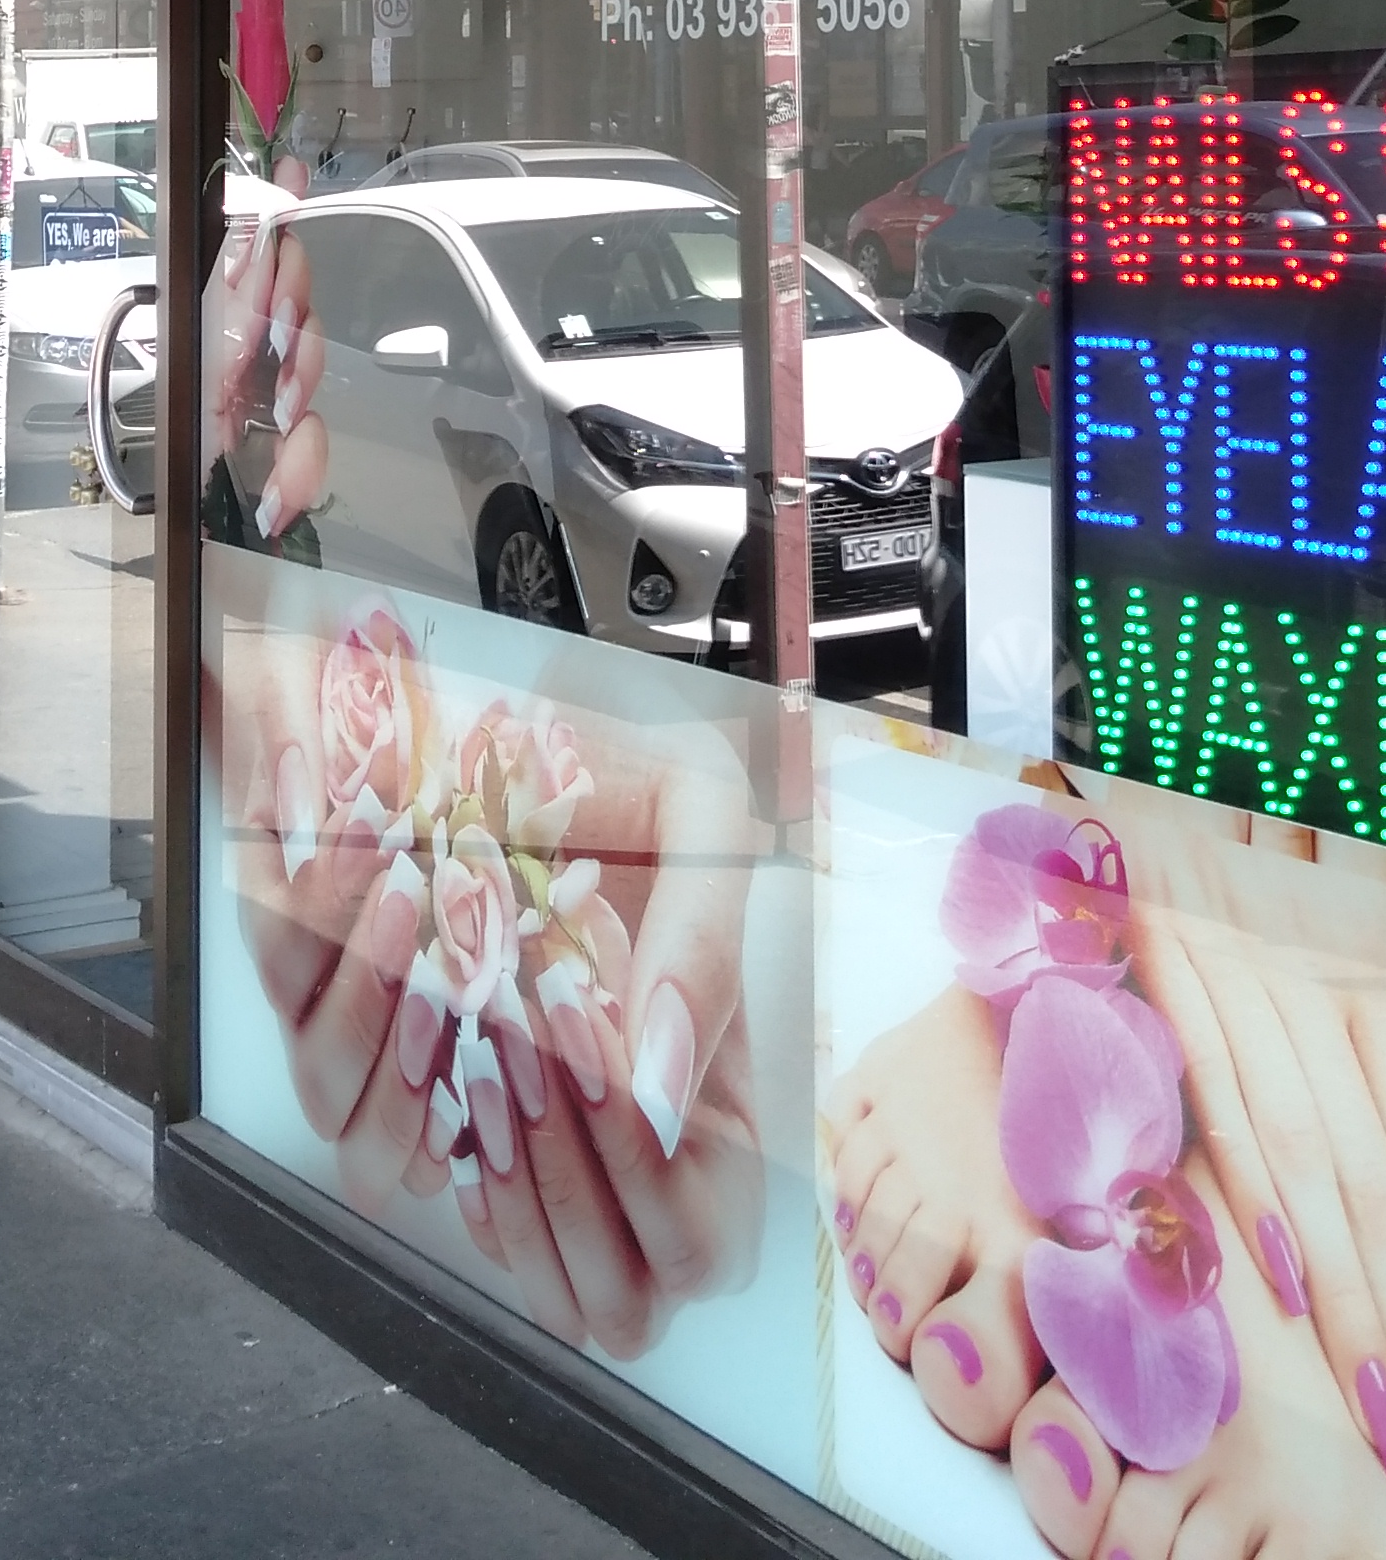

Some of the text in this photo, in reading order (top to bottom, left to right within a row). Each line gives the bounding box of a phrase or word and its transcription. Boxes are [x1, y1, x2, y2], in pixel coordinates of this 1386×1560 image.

[47, 223, 115, 251] YES, We are
[1070, 89, 1351, 292] NAILS
